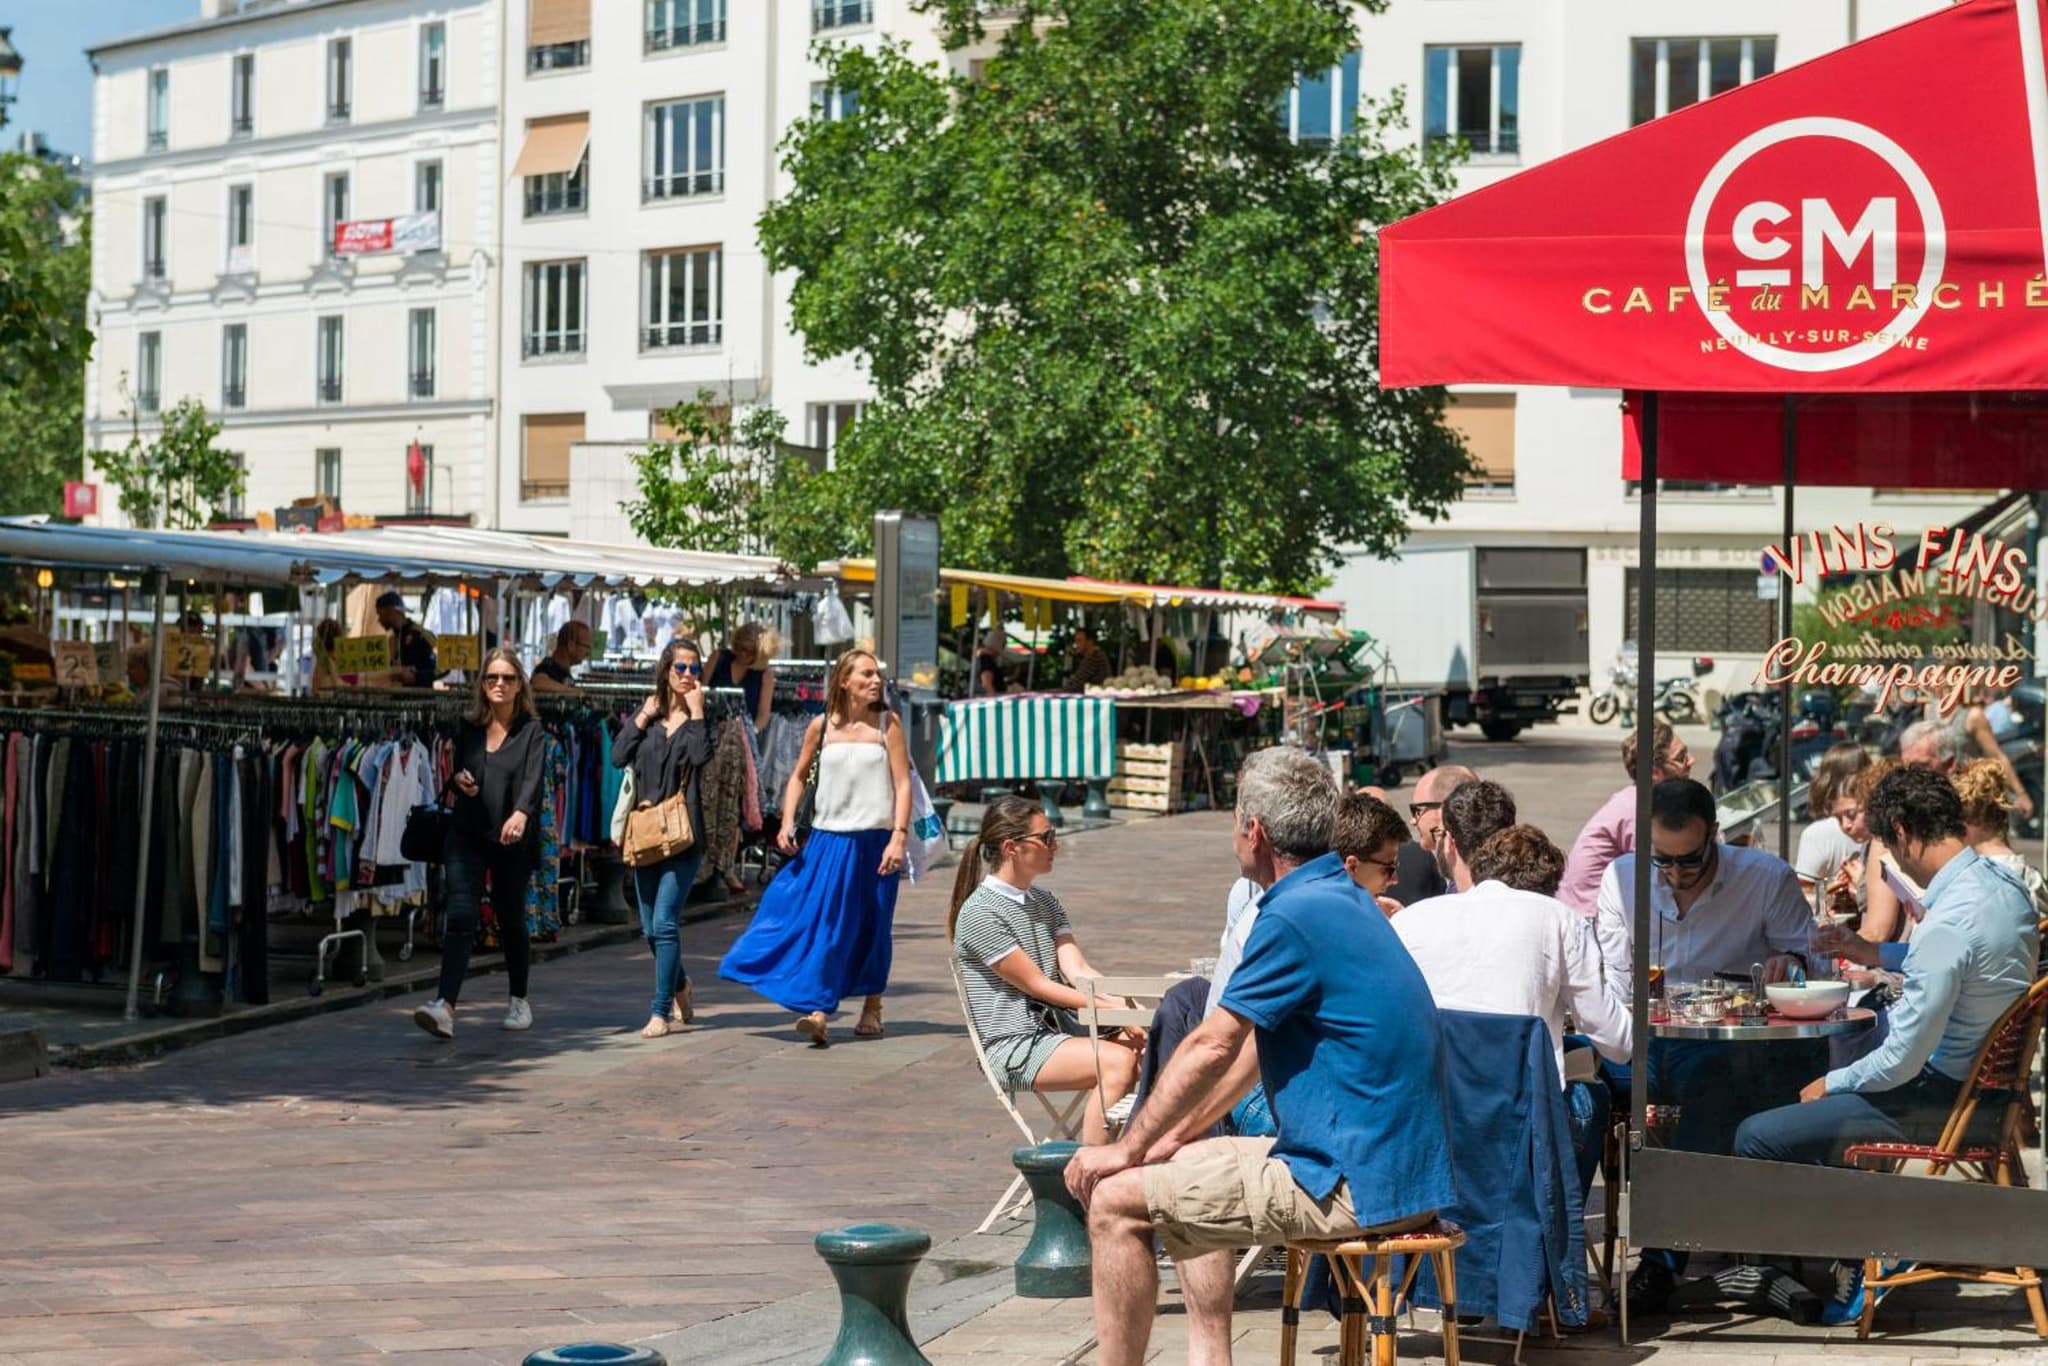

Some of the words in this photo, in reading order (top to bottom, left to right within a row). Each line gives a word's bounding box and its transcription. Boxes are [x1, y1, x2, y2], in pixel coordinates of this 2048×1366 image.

[1581, 278, 1732, 314] CAFÉ
[1750, 282, 1783, 311] du
[1800, 273, 2048, 311] MARCHÉ
[1700, 330, 1930, 353] NEUILLY-SUR-SEINE
[1763, 522, 1897, 585] VINS
[1915, 523, 2028, 596] FINS
[1752, 636, 2023, 717] Champagne
